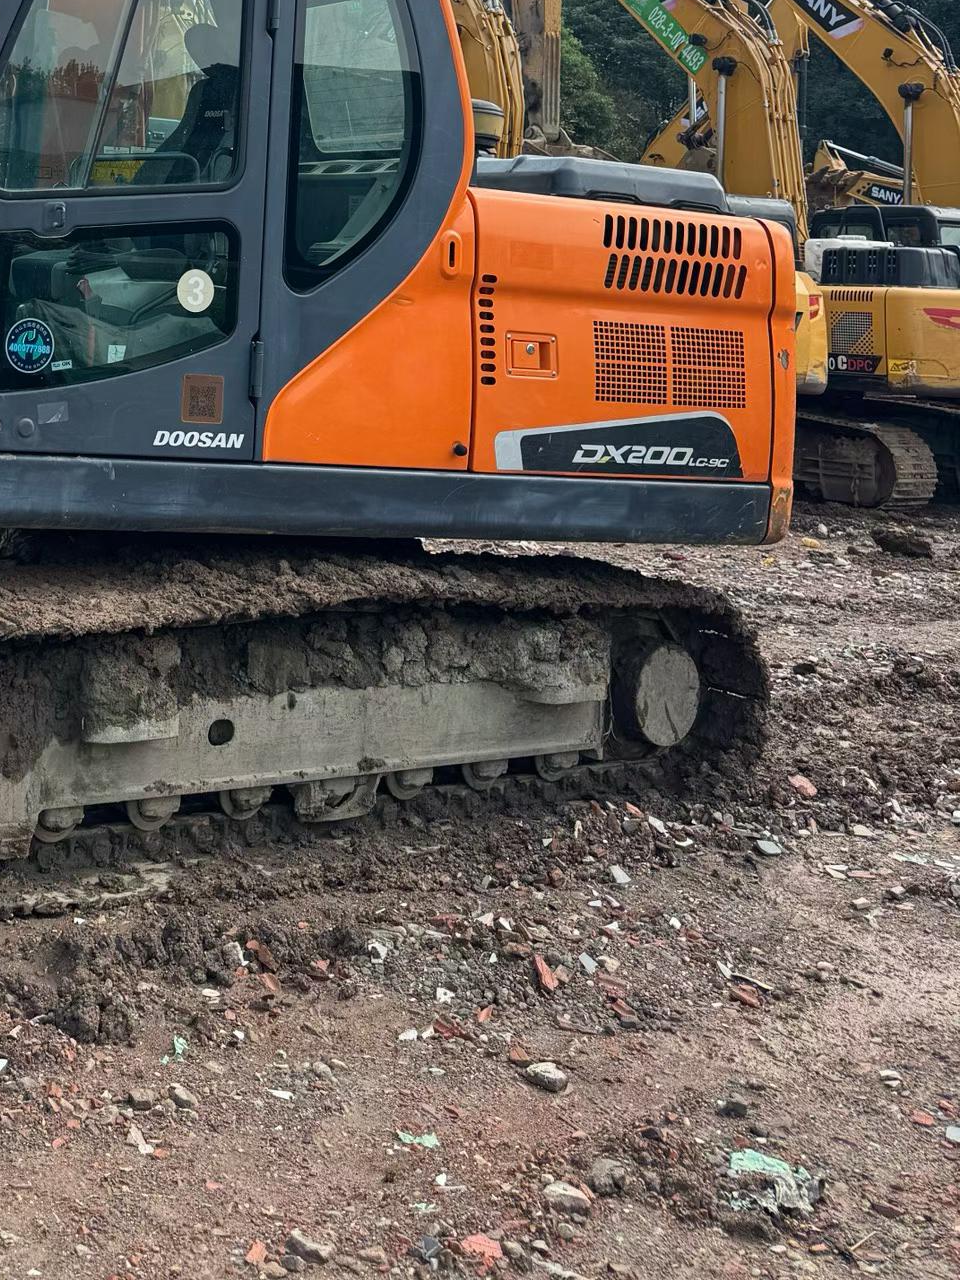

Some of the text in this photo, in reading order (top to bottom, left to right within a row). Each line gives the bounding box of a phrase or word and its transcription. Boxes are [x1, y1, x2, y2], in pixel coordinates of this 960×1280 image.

[871, 186, 900, 204] SANY
[187, 276, 205, 306] 3
[152, 430, 245, 449] DOOSAN
